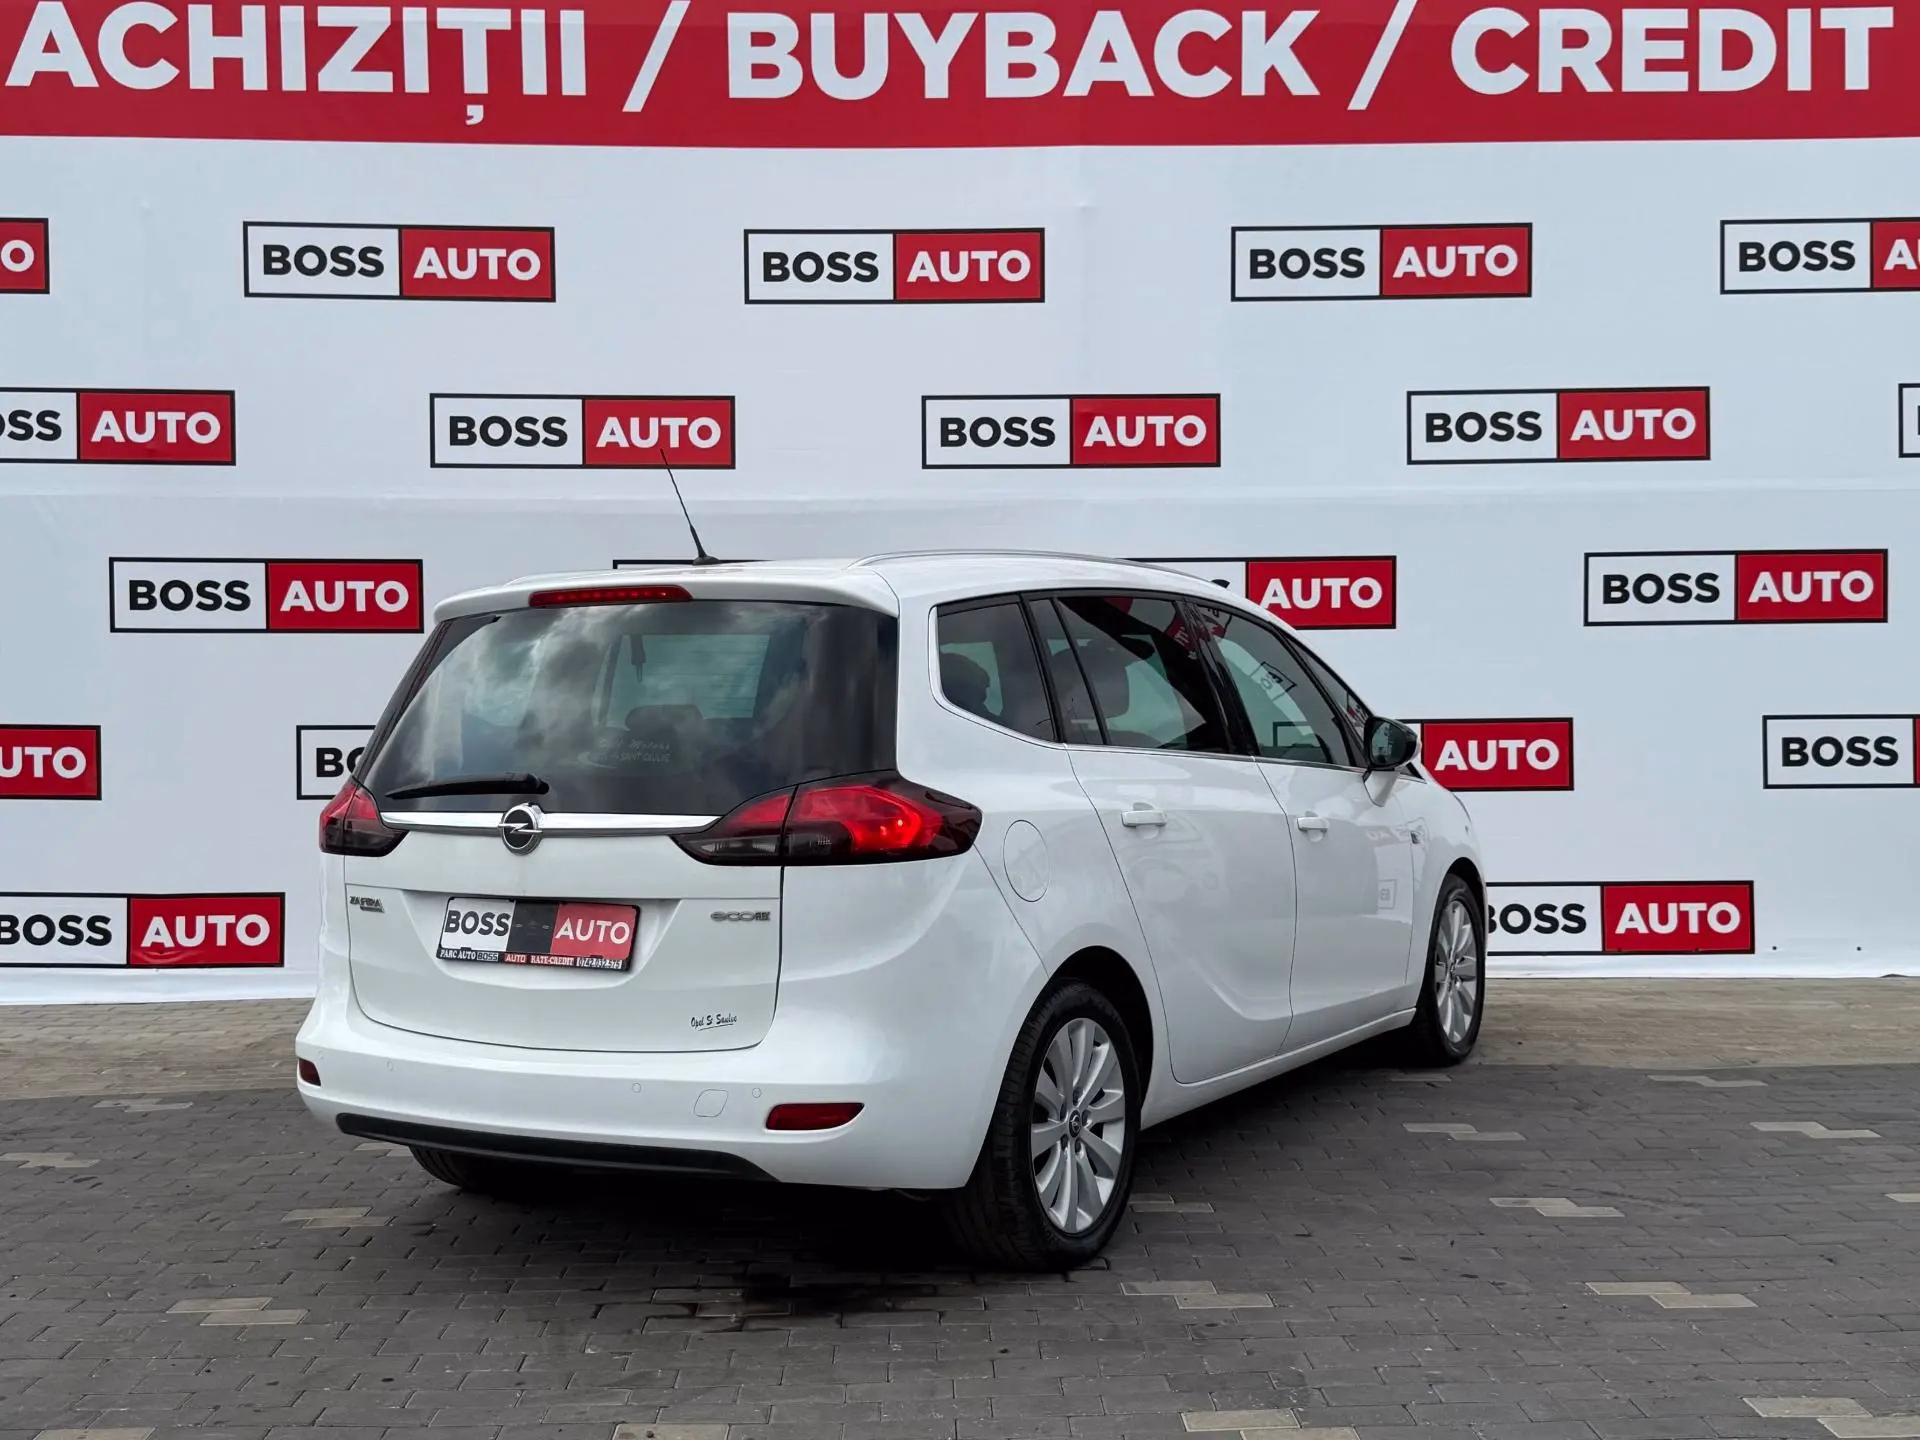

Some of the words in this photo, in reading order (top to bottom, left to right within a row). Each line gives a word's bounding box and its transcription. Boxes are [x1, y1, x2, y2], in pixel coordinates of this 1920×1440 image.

[5, 0, 587, 125] ACHIZIȚII
[727, 9, 1321, 101] BUYBACK
[1451, 6, 1894, 95] CREDIT
[263, 245, 384, 277] BOSS
[414, 248, 541, 281] AUTO
[763, 251, 879, 283] BOSS
[907, 250, 1031, 283] AUTO
[1250, 247, 1366, 280] BOSS
[1393, 245, 1518, 278] AUTO
[1740, 240, 1856, 273] BOSS
[1884, 238, 1920, 271] A
[0, 409, 62, 442] SS
[91, 410, 221, 444] AUTO
[450, 416, 568, 448] BOSS
[596, 416, 722, 449] AUTO
[941, 417, 1056, 448] BOSS
[1083, 415, 1207, 447] AUTO
[1426, 411, 1543, 443] BOSS
[1571, 407, 1697, 441] AUTO
[129, 580, 251, 612] BOSS
[281, 581, 409, 613] AUTO
[1259, 577, 1382, 609] AUTO
[1603, 572, 1721, 605] BOSS
[1749, 570, 1874, 603] AUTO
[0, 746, 87, 779] UTO
[1434, 739, 1560, 771] AUTO
[1782, 735, 1899, 768] BOSS
[0, 913, 113, 947] BOSS
[140, 914, 270, 948] AUTO
[444, 909, 512, 937] BOSS
[554, 917, 631, 945] AUTO
[1615, 901, 1741, 934] AUTO
[440, 949, 457, 958] PARC
[457, 951, 476, 960] AUTO
[478, 953, 498, 961] BOSS
[505, 954, 526, 964] AUTO
